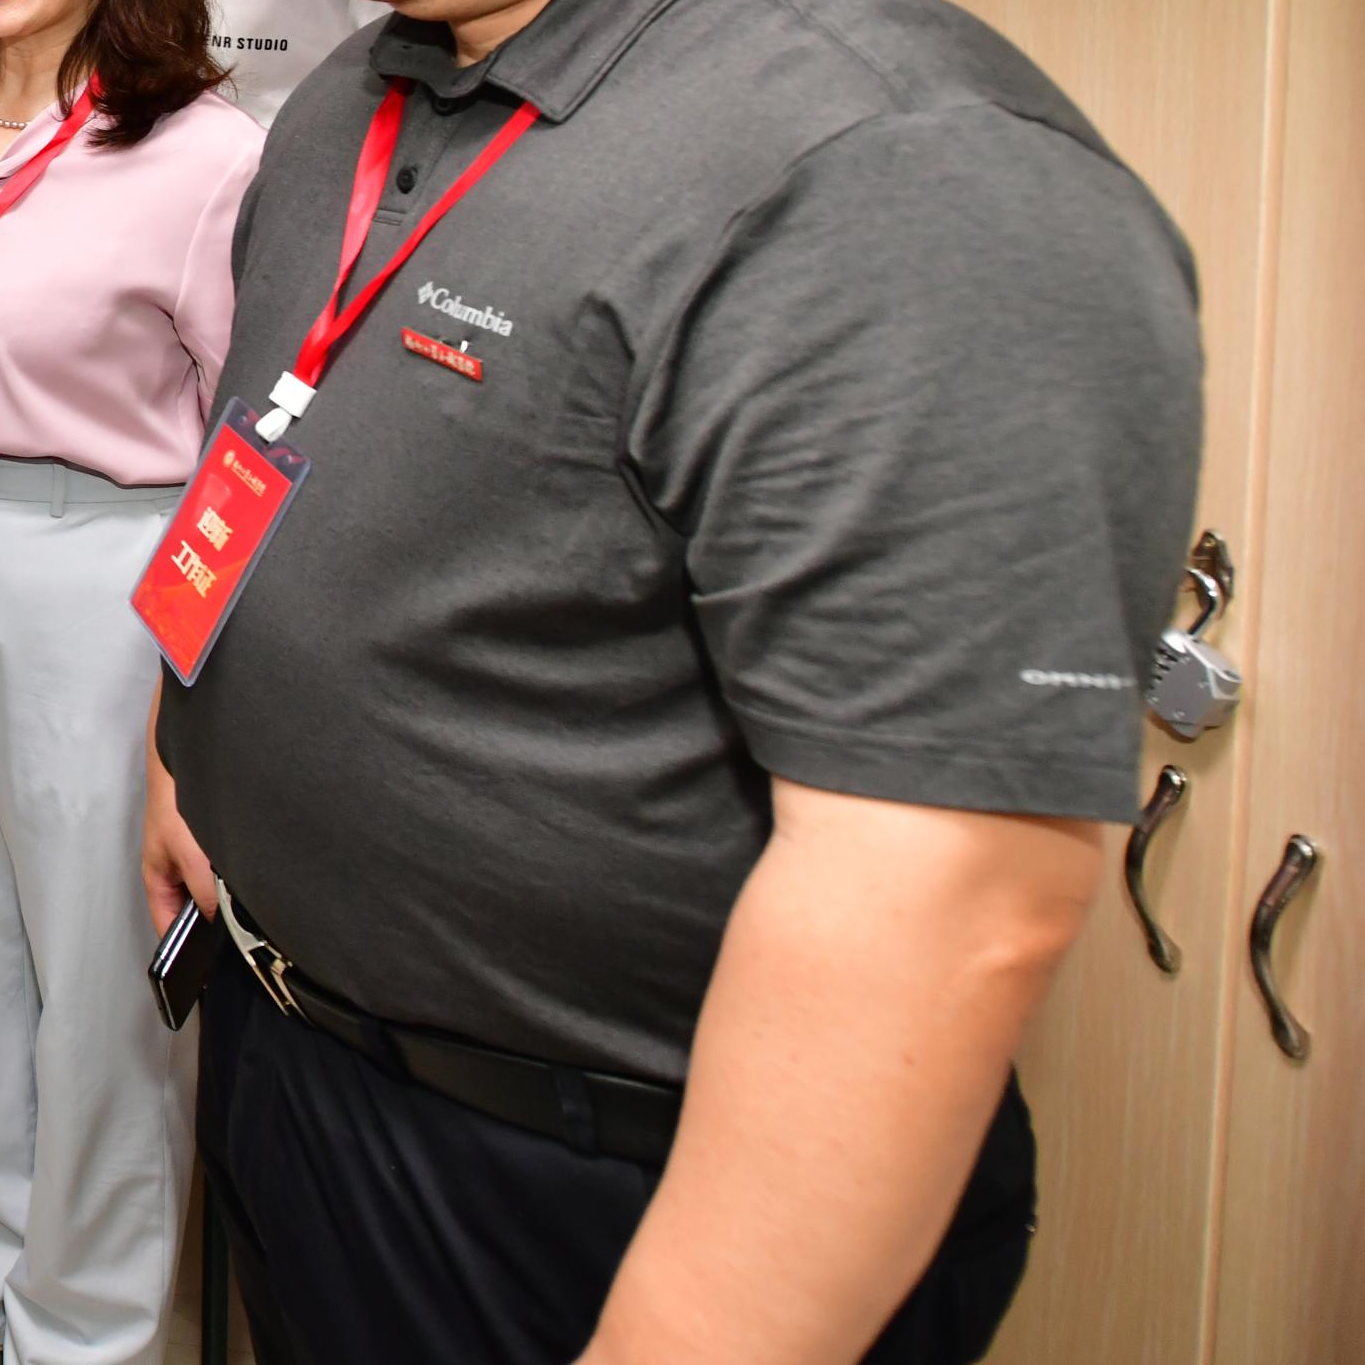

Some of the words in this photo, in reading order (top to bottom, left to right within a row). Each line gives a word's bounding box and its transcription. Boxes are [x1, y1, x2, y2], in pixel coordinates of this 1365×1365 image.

[236, 37, 289, 52] STUDIO
[429, 287, 514, 337] Columbia
[195, 506, 234, 553] 迎新
[170, 538, 218, 598] 工作证
